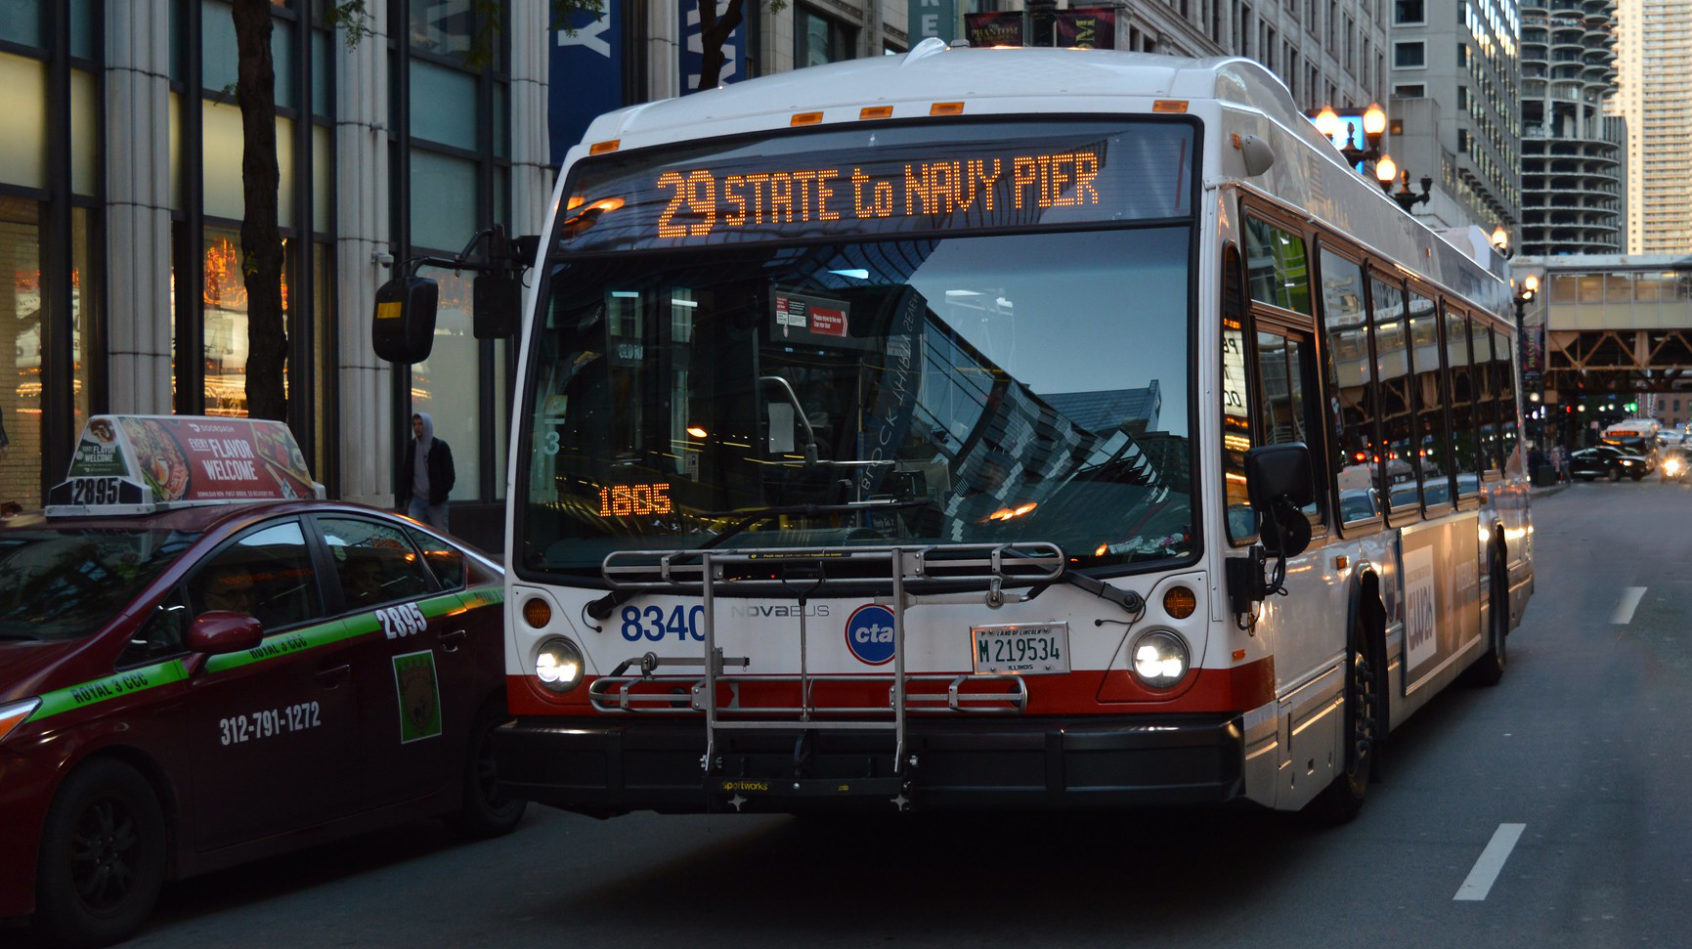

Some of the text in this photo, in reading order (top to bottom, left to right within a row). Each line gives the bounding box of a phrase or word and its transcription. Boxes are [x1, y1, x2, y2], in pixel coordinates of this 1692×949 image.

[657, 152, 1098, 238] 29 STATE to NAVY PIER
[188, 438, 255, 459] EVERY FLAVOR
[202, 459, 259, 480] WELCOME
[73, 478, 119, 505] 2895
[598, 483, 671, 517] 1805
[375, 602, 428, 640] 2895
[621, 605, 705, 642] 8340
[855, 623, 894, 643] cta
[249, 634, 308, 659] ROYAL 3 CCC
[979, 637, 1060, 662] M 219534
[71, 672, 148, 704] ROYAL 3 CCC
[219, 700, 322, 747] 312-791-1272
